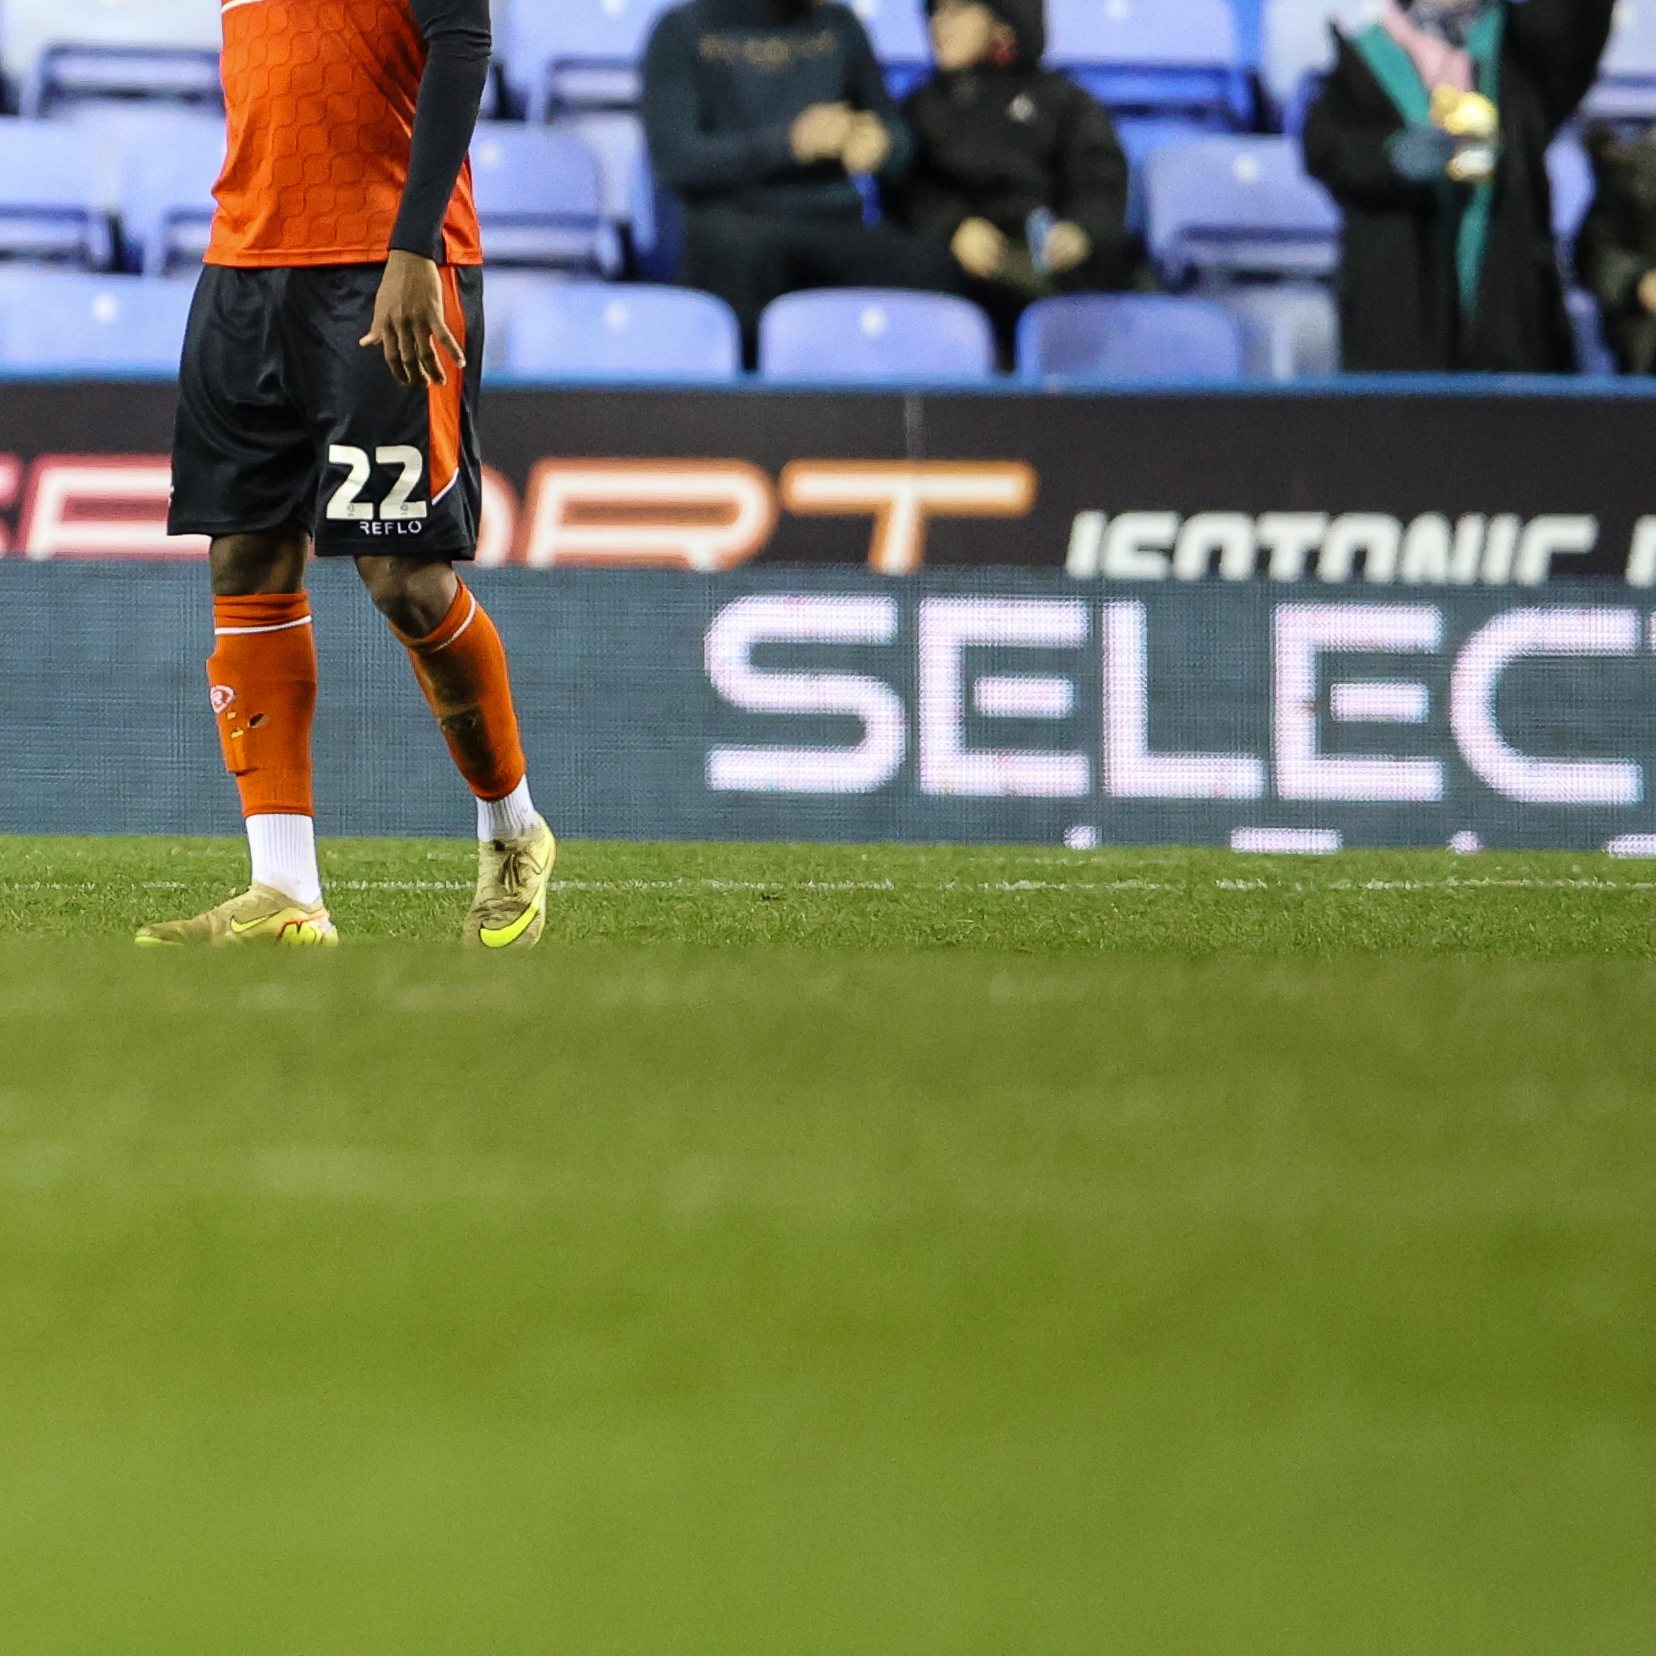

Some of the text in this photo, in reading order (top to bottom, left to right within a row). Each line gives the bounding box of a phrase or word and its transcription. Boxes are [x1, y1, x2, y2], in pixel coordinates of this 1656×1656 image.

[326, 444, 428, 521] 22
[359, 521, 423, 535] REFLO
[702, 593, 1656, 805] SELEC
